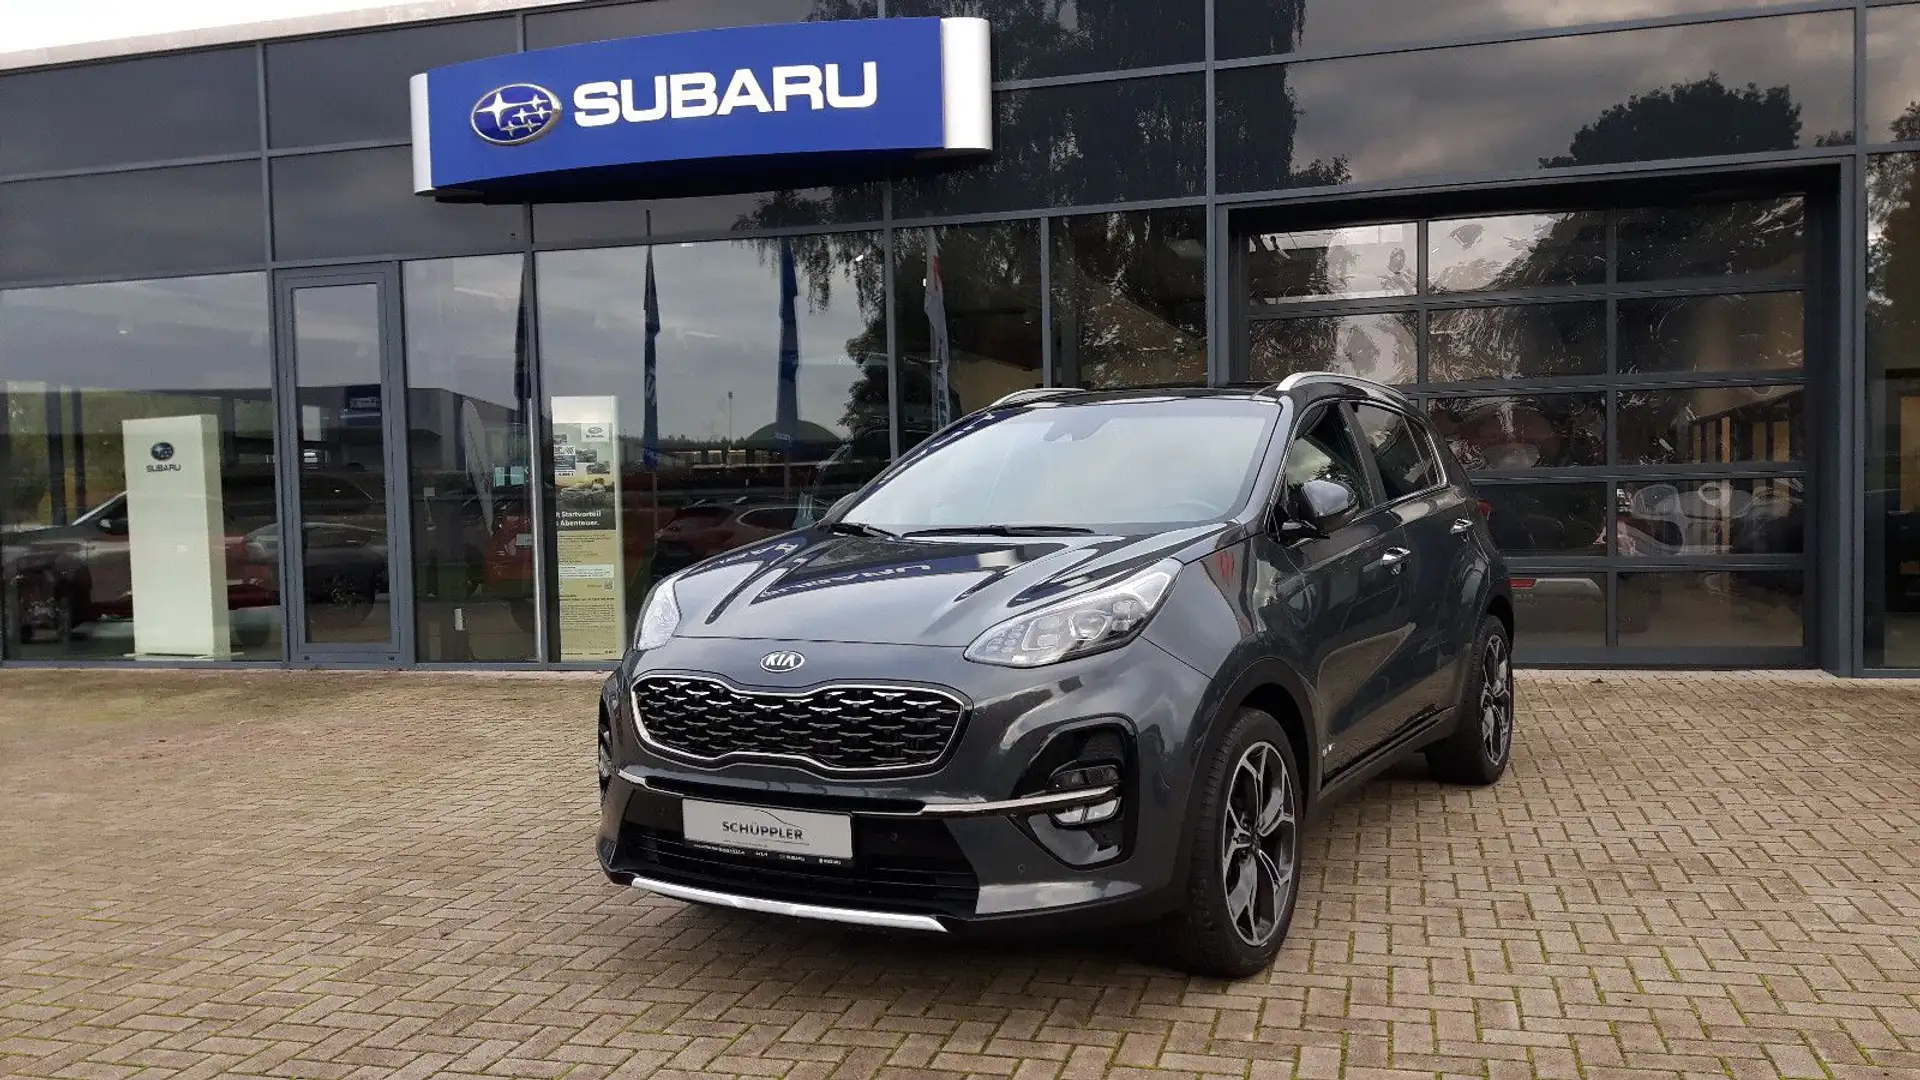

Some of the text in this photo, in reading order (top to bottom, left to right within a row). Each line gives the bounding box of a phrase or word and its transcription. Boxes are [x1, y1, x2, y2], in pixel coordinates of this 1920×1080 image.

[573, 61, 878, 128] SUBARU
[146, 464, 181, 472] SUBARU
[561, 510, 602, 518] Startvorteil
[722, 820, 803, 840] SCHÜPPLER
